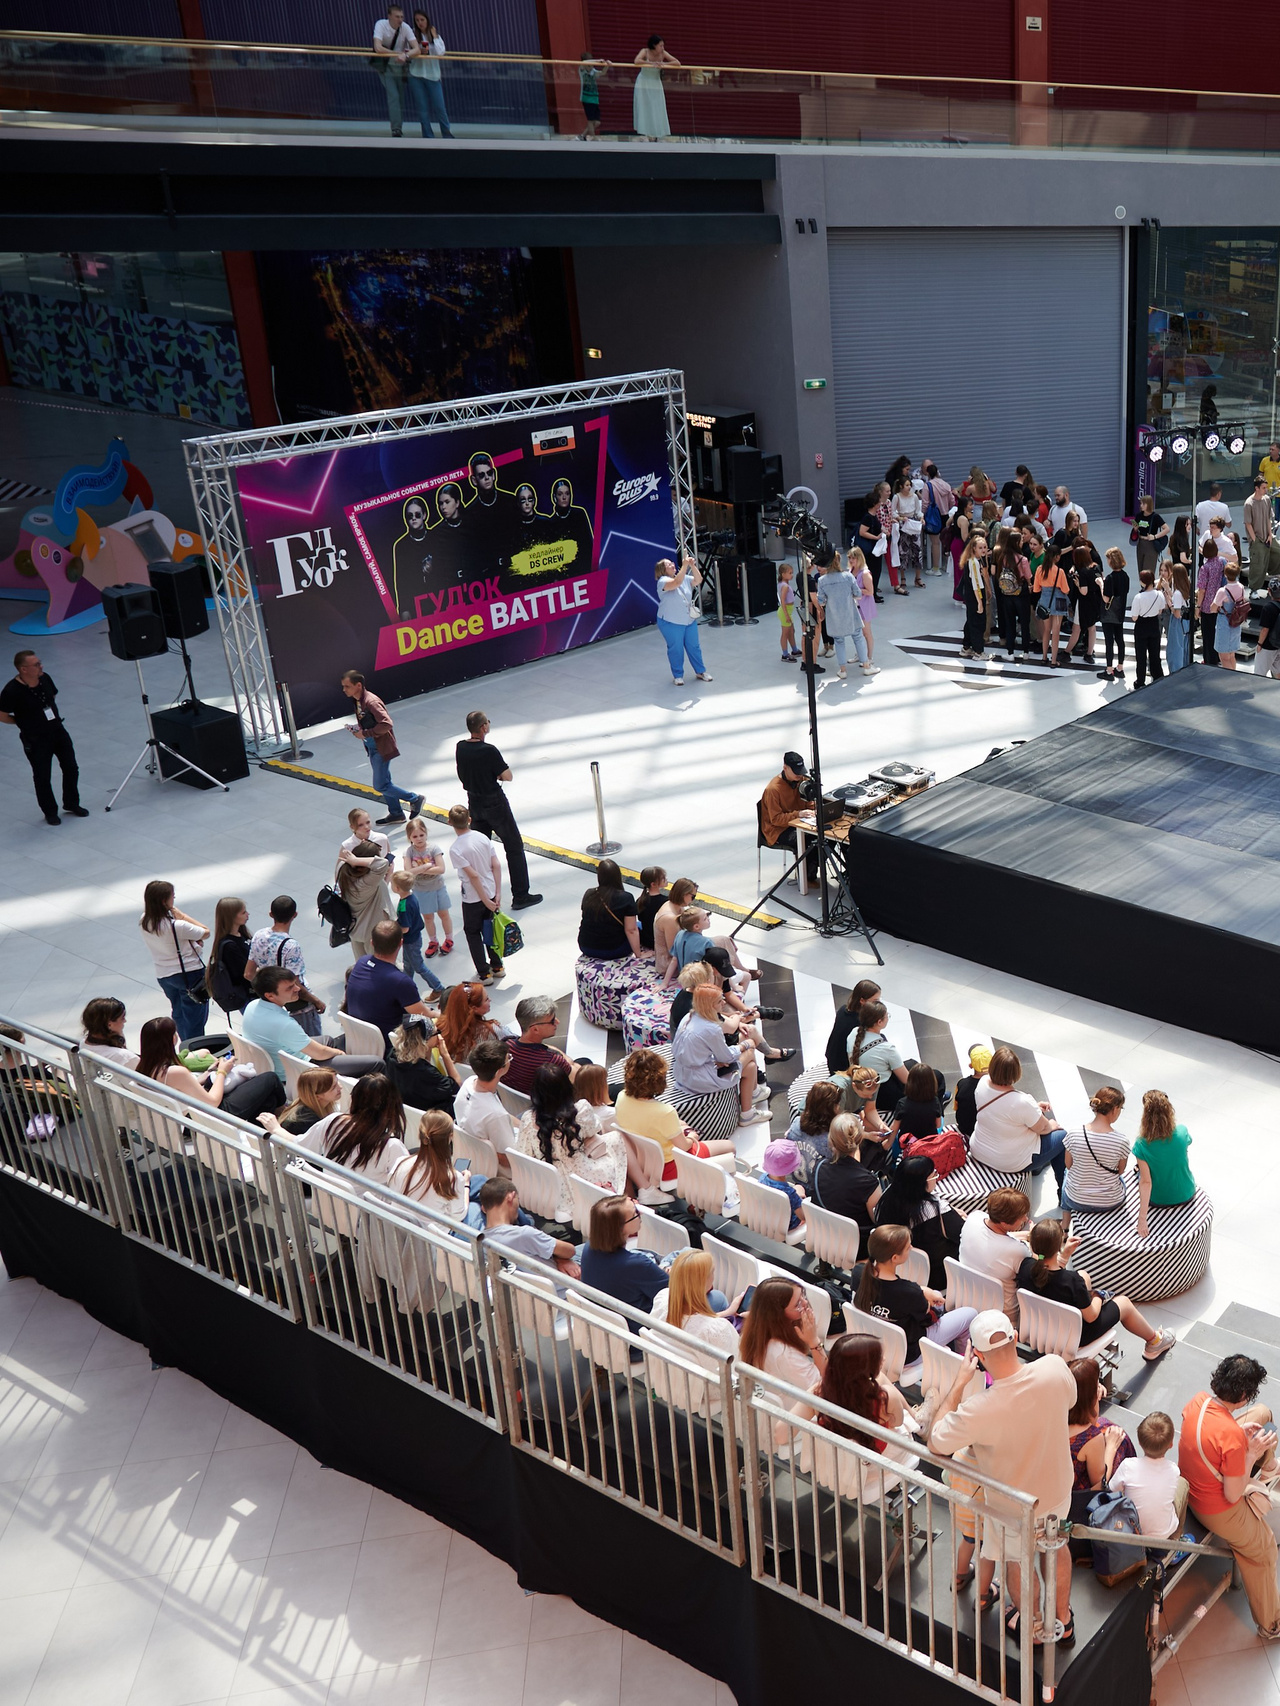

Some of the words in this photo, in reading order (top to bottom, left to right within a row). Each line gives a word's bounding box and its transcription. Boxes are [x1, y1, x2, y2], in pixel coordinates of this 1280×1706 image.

[353, 491, 401, 512] МУЗЫКАЛЬНОЕ
[401, 481, 429, 497] СОБЫТИЕ
[430, 475, 448, 487] ЭТОГО
[449, 470, 464, 481] ЛЕТА
[359, 535, 372, 560] САМОЕ
[528, 545, 564, 560] хедлайнер
[529, 559, 541, 569] DS
[542, 554, 565, 566] CREW
[396, 614, 484, 656] Dance
[490, 579, 590, 630] BATTLE
